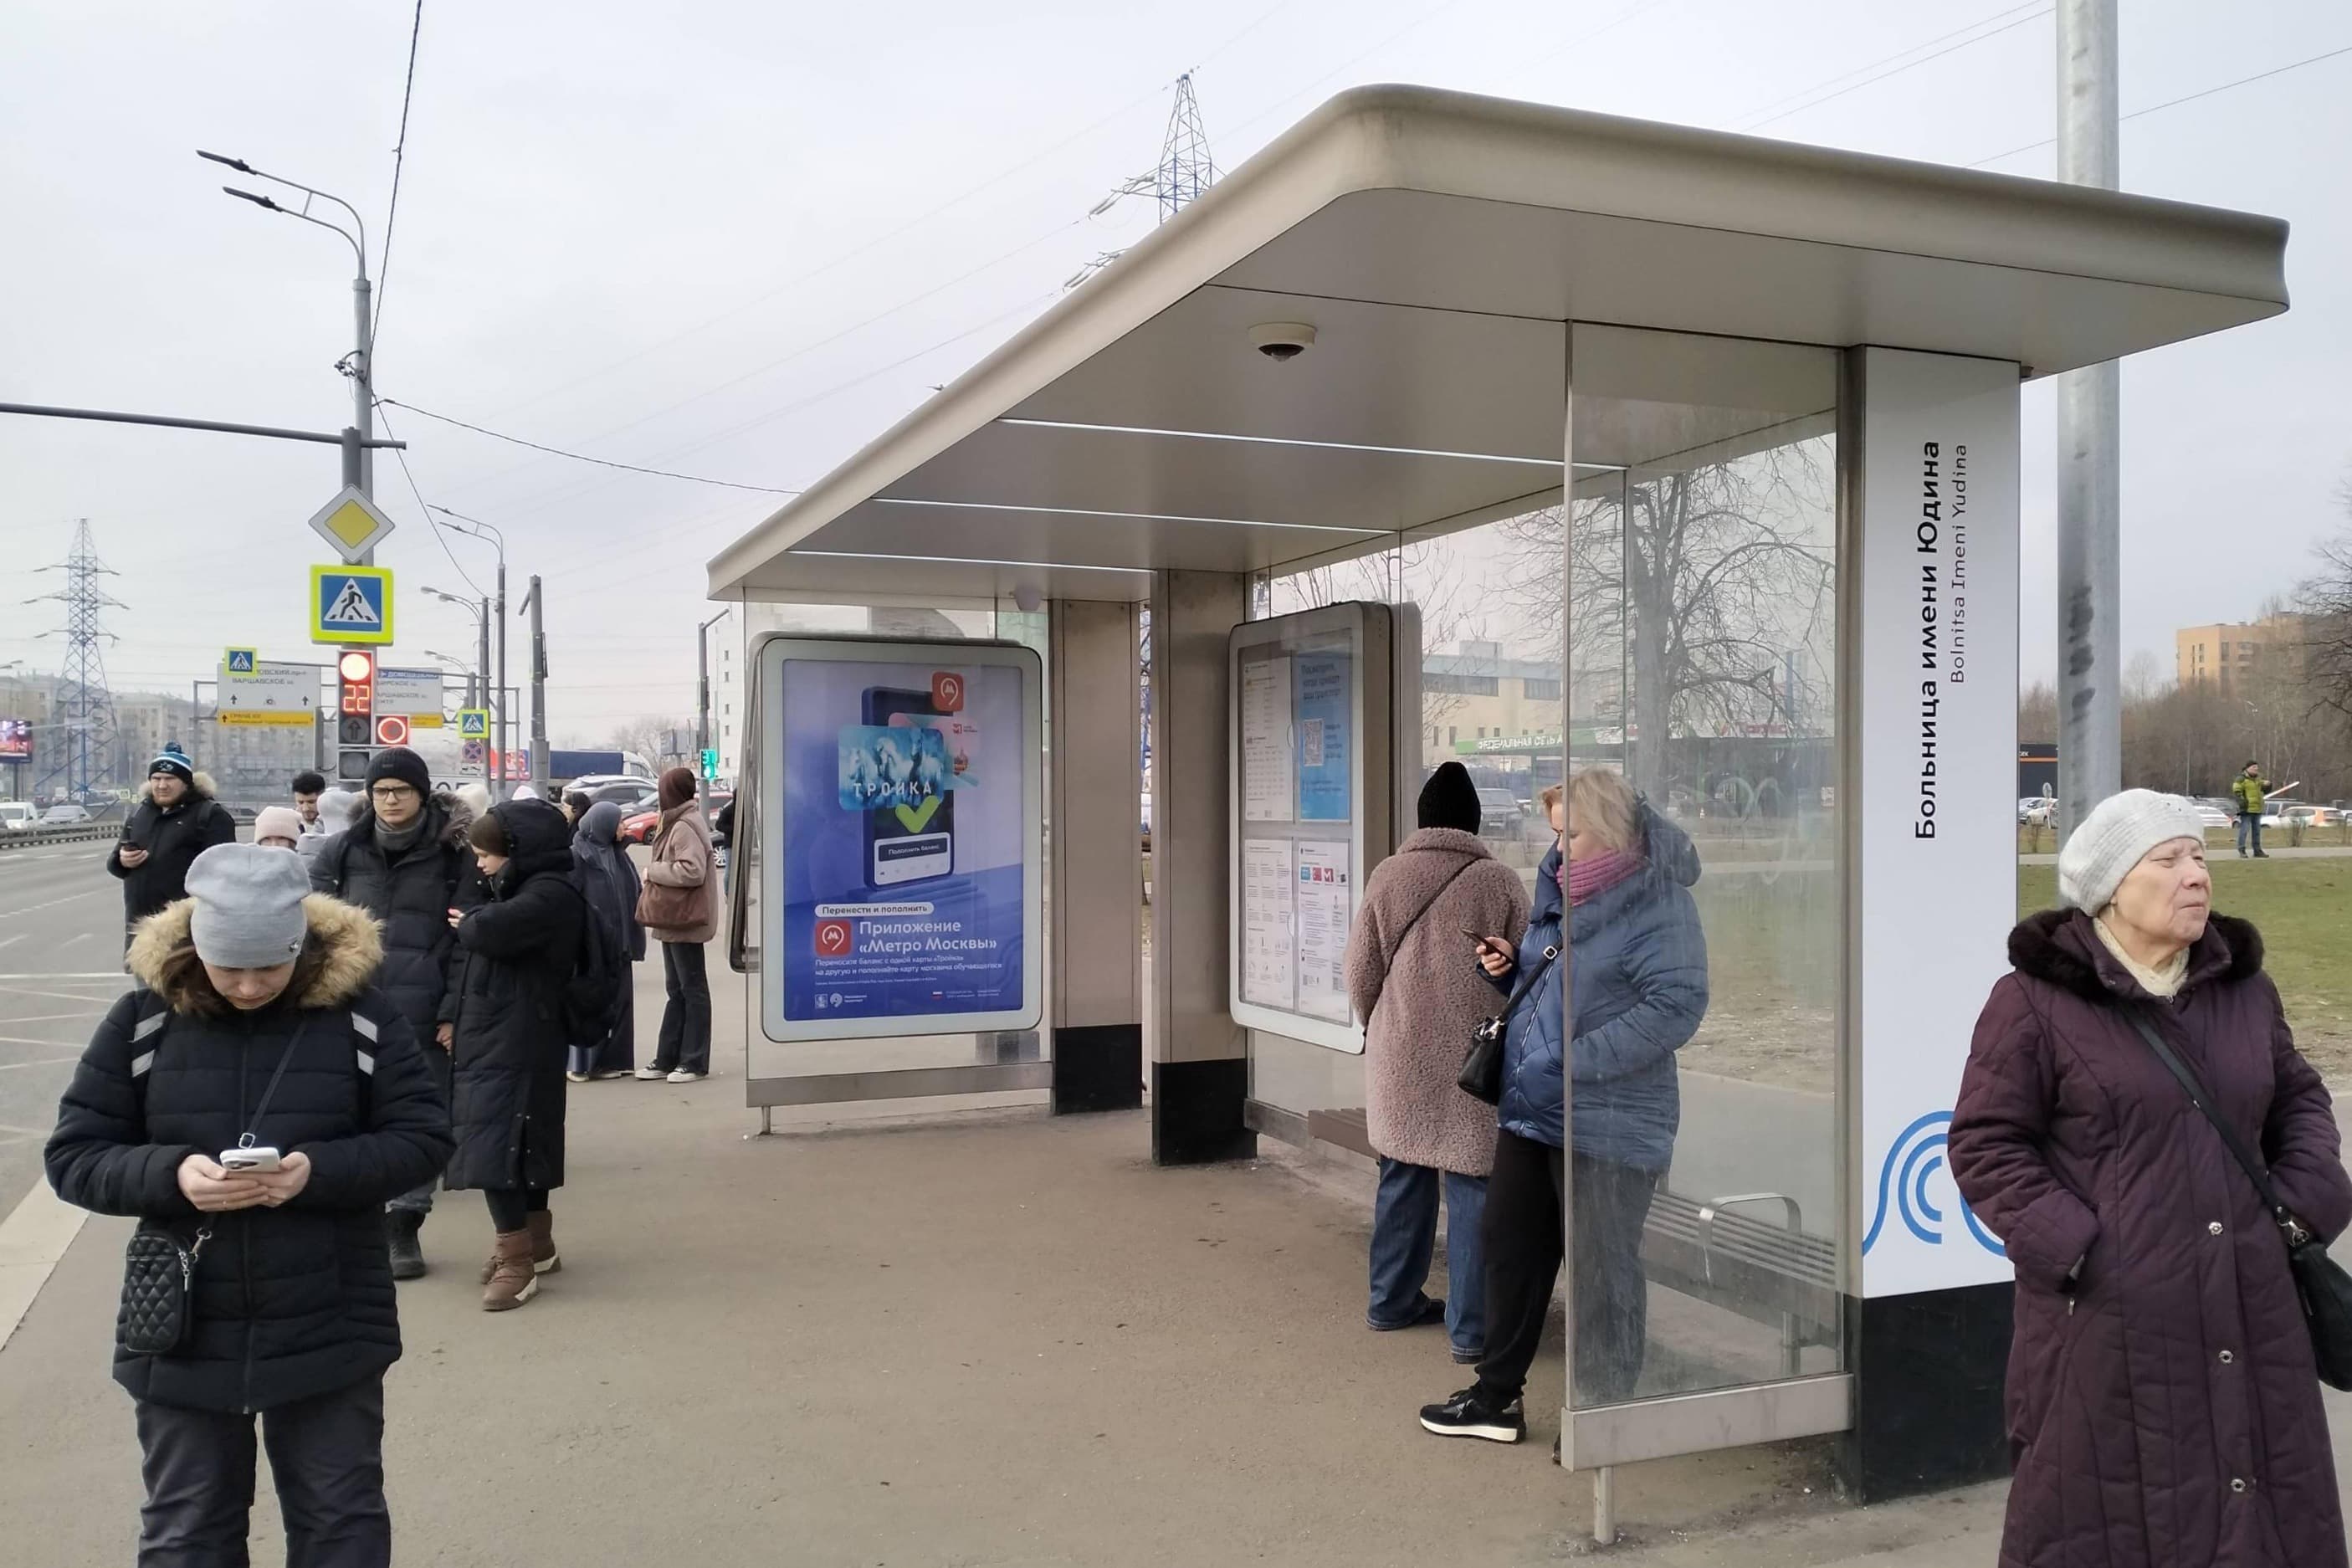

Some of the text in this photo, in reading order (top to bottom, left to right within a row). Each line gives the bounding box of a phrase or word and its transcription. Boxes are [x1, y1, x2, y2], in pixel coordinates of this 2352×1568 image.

[1950, 443, 1968, 684] Bolnitsa Imeni Yudina
[1915, 441, 1941, 839] Больница имени Юдина
[343, 684, 370, 712] 22
[822, 906, 872, 916] Перенести
[881, 904, 928, 914] пополнить
[858, 920, 961, 936] Приложение
[858, 937, 997, 954] «Метро Москвы»
[825, 968, 851, 976] другую
